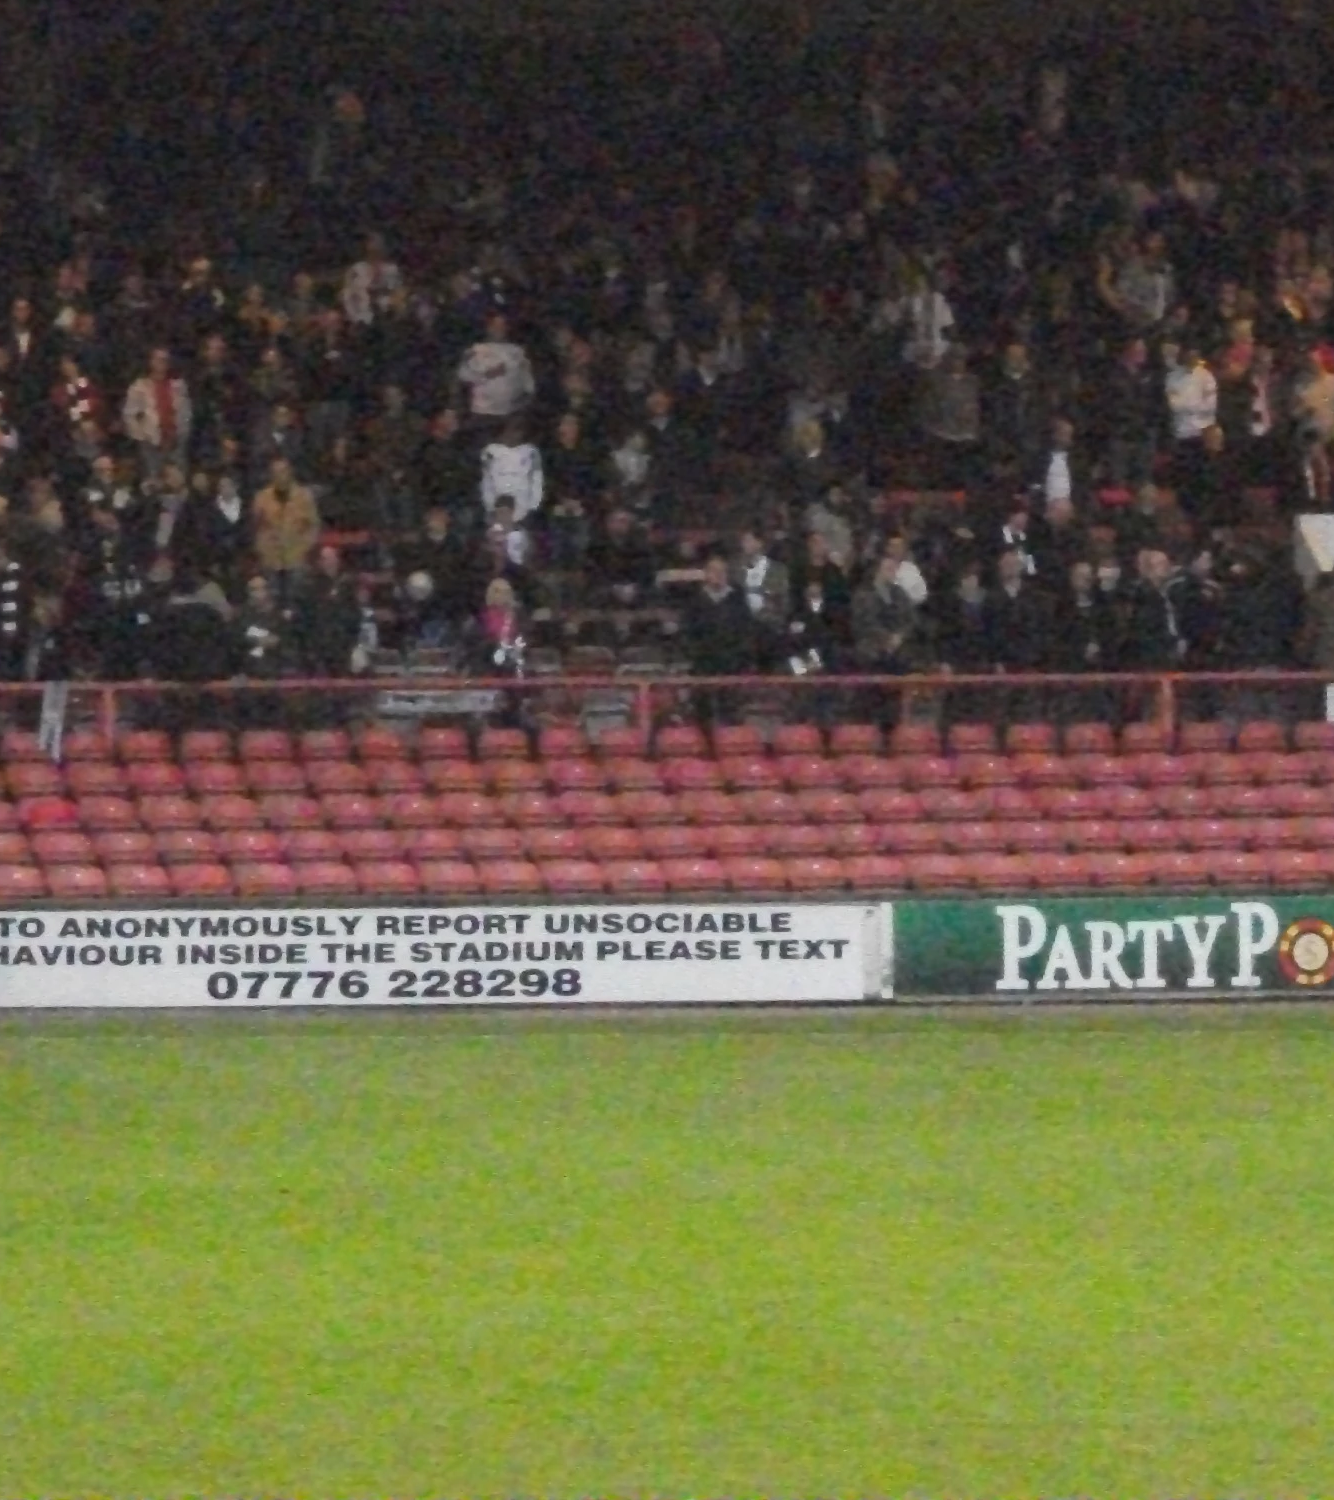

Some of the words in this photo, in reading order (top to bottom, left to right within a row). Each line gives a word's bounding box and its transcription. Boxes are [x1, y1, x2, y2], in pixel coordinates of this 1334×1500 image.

[58, 915, 363, 939] ANONYMOUSLY
[376, 914, 531, 936] REPORT
[545, 912, 792, 935] UNSOCIABLE
[177, 944, 308, 966] INSIDE
[321, 942, 396, 964] THE
[410, 941, 584, 963] STADIUM
[597, 940, 742, 961] PLEASE
[754, 939, 849, 960] TEXT
[207, 970, 371, 1000] 07776
[388, 967, 584, 998] 228298
